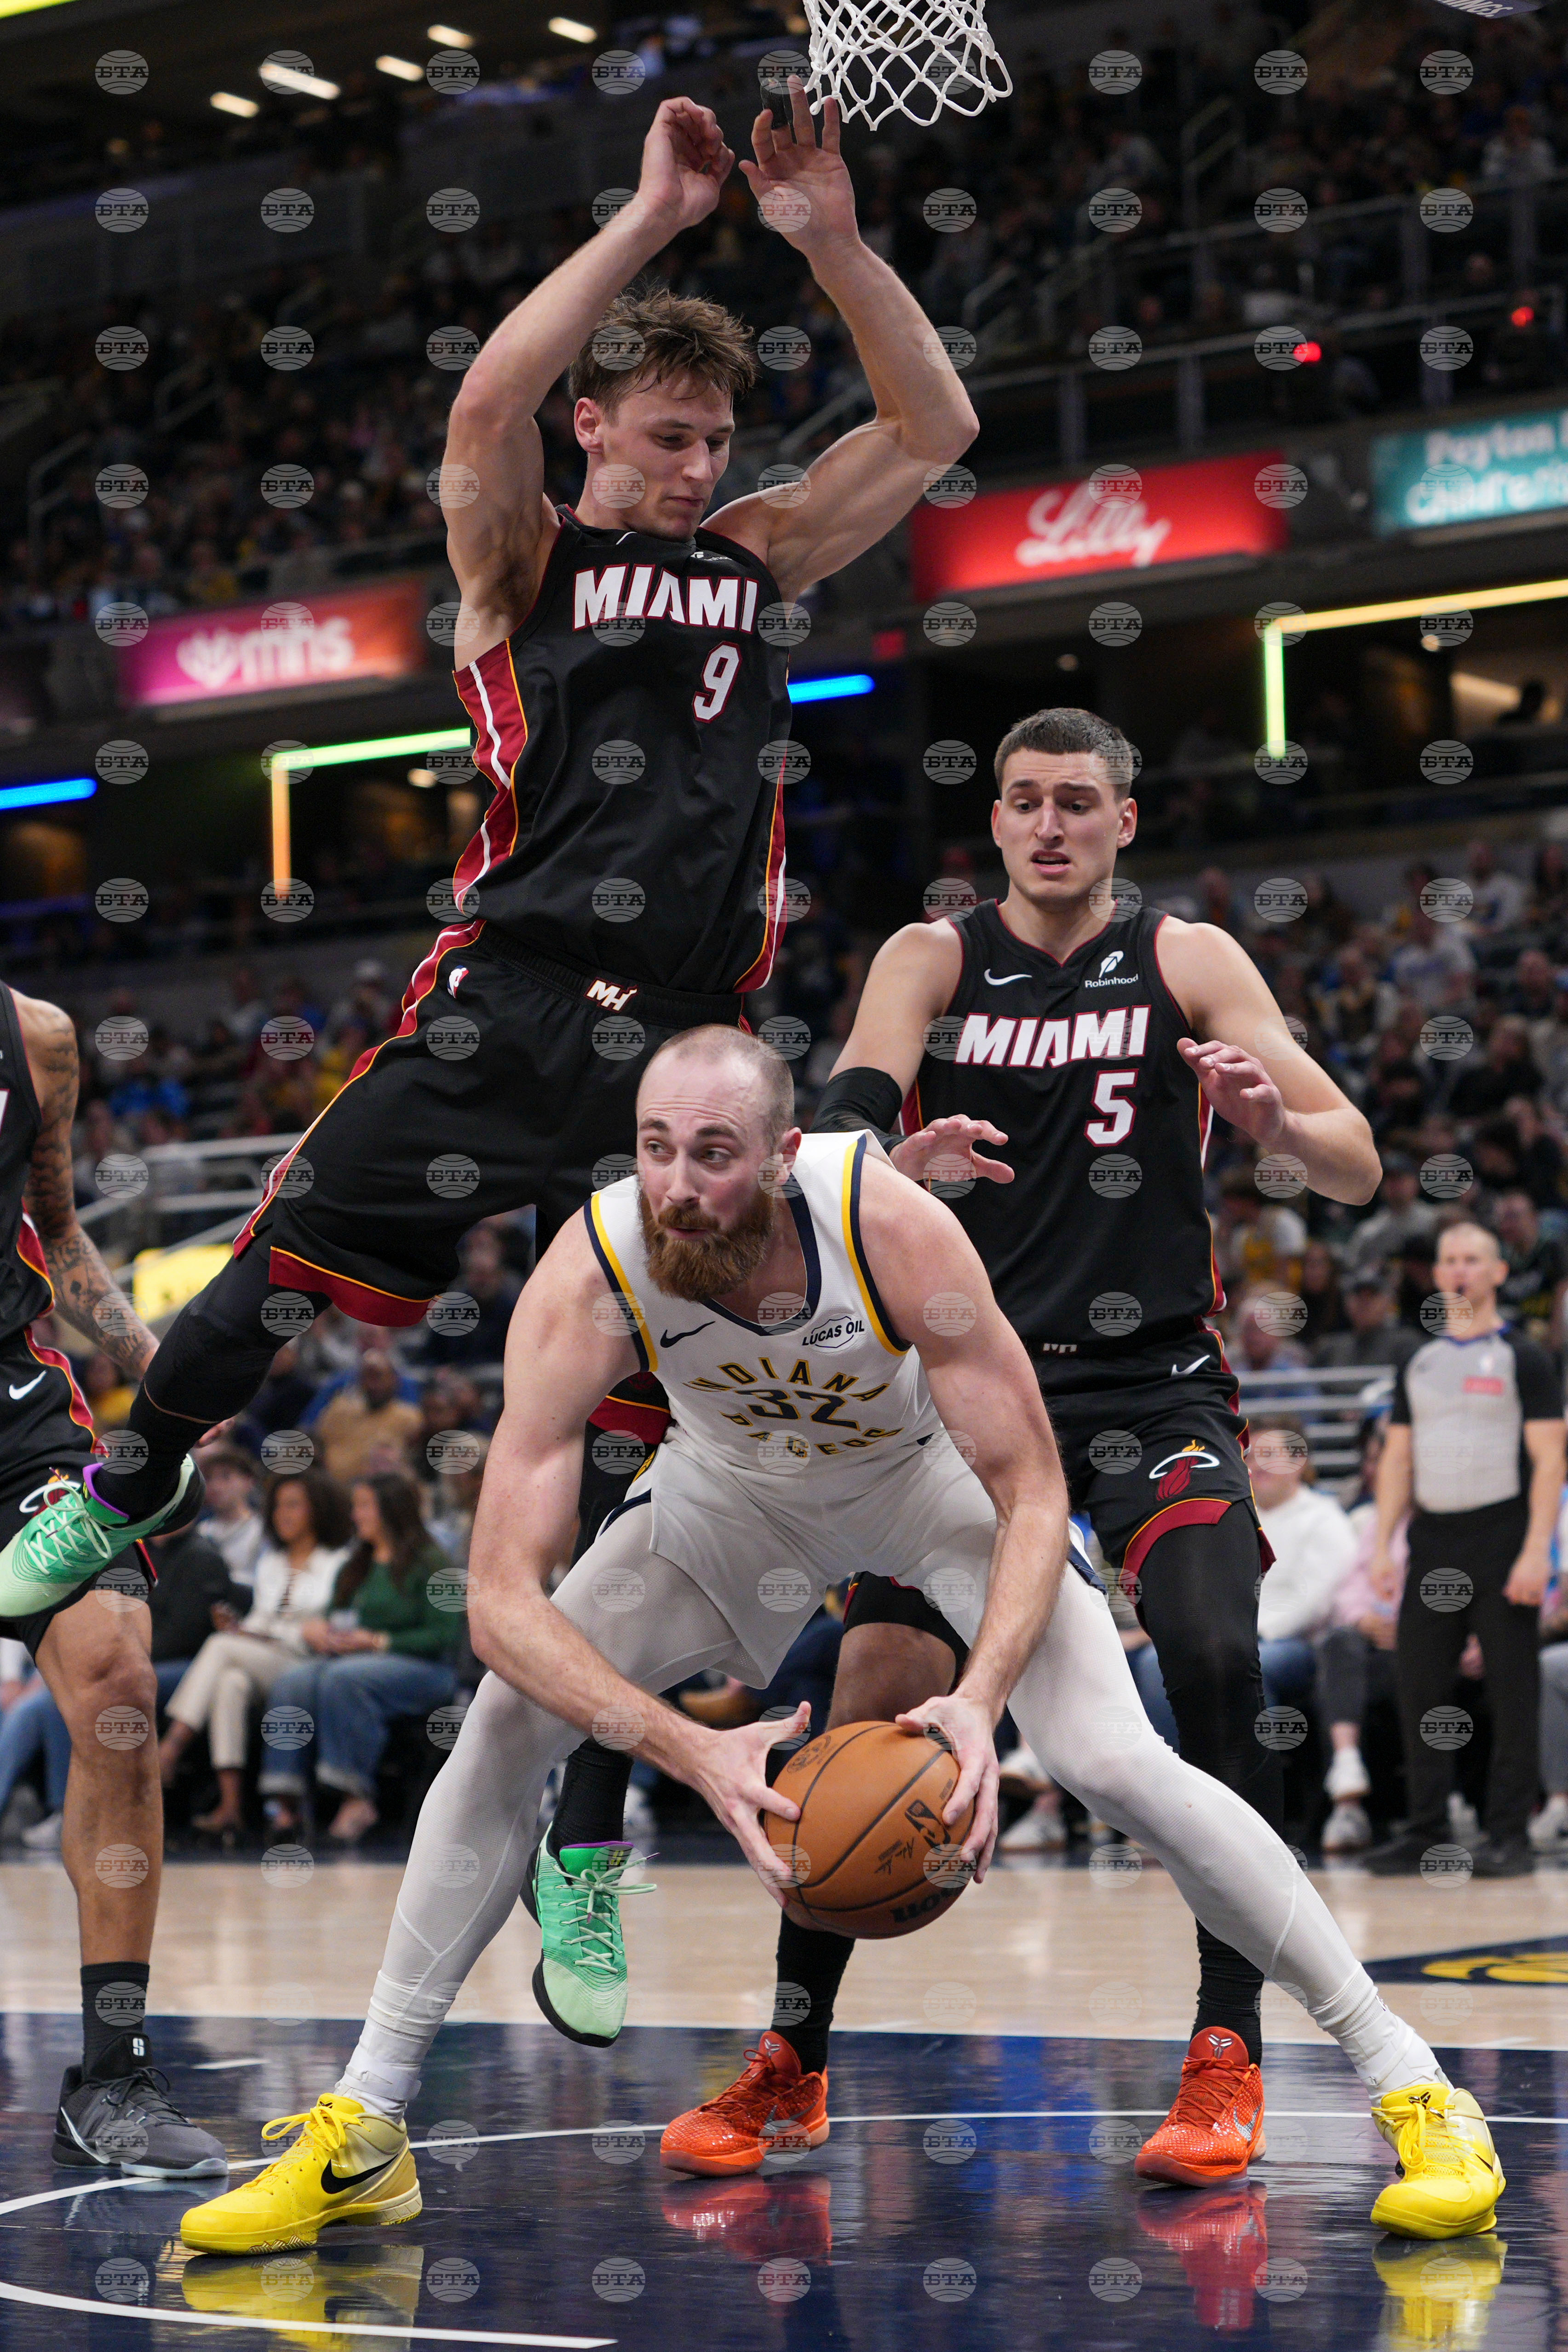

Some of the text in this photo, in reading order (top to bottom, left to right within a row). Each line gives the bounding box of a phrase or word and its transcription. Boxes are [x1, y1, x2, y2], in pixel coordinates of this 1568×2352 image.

[572, 563, 759, 635] MIAMI
[691, 640, 742, 723] 9
[1085, 973, 1139, 988] Robinhood
[953, 1004, 1152, 1069] MIAMI
[1084, 1068, 1139, 1147] 5
[802, 1320, 865, 1346] LUCAS OIL
[735, 1389, 861, 1431] 32
